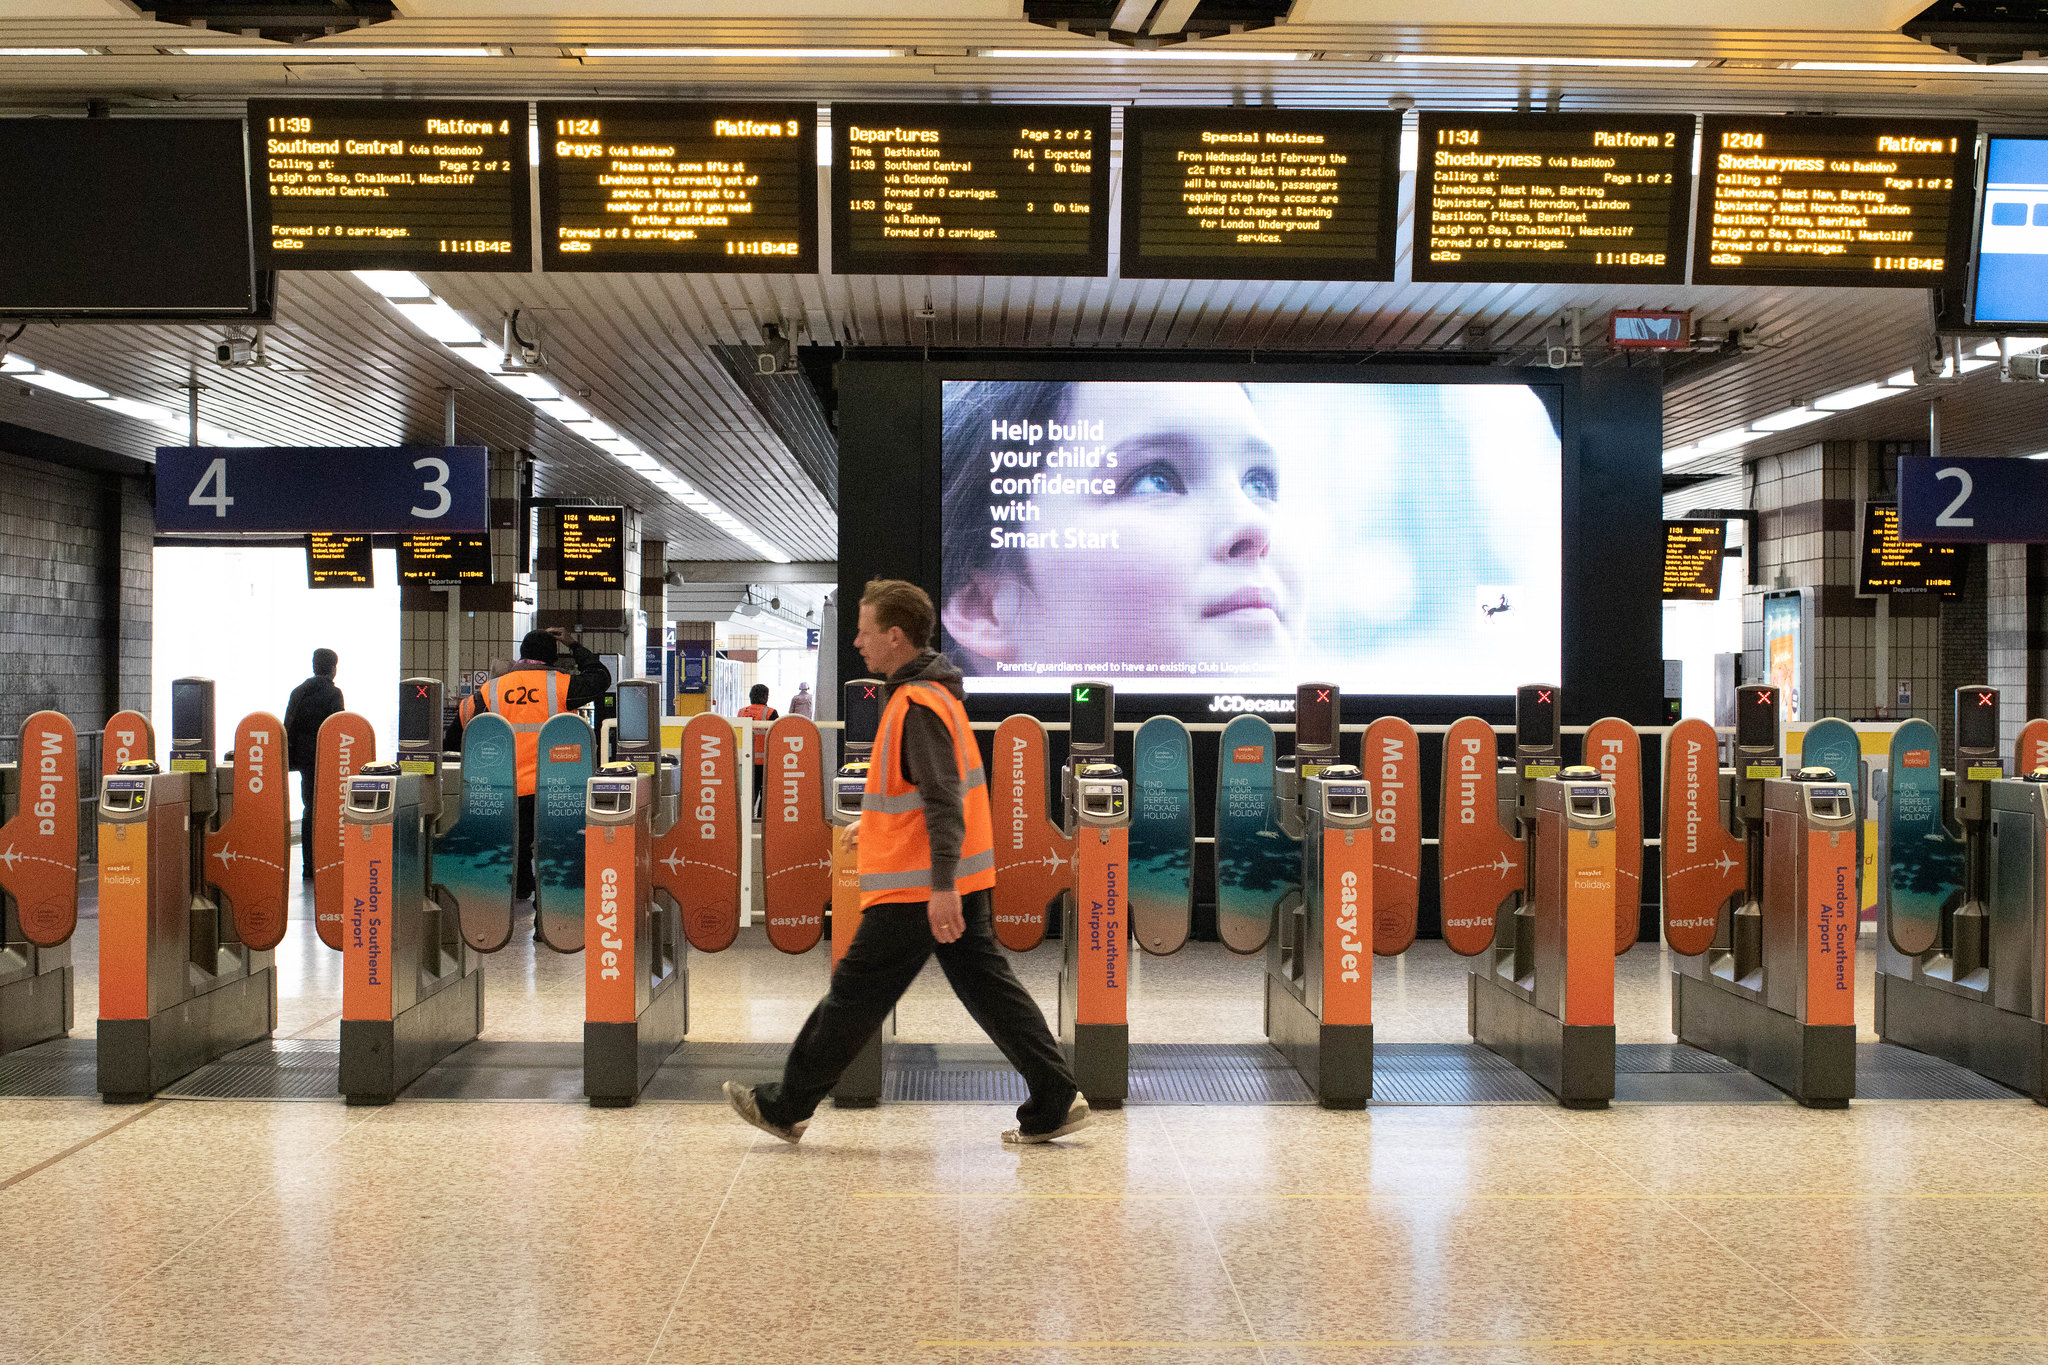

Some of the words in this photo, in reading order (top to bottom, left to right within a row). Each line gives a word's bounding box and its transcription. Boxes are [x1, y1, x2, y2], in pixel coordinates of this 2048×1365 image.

[268, 118, 310, 132] 11:39
[428, 119, 492, 134] Platform
[500, 120, 509, 134] 4
[557, 120, 599, 135] 11:24
[715, 120, 781, 136] Platform
[788, 121, 798, 136] 3
[850, 127, 939, 143] Departures
[1022, 129, 1049, 141] Page
[1054, 130, 1062, 139] 2
[1066, 130, 1079, 139] of
[1084, 131, 1091, 140] 2
[1202, 132, 1259, 143] Special
[1266, 133, 1324, 143] Notices
[1438, 130, 1479, 144] 11:34
[1594, 132, 1658, 147] Platform
[1665, 133, 1675, 147] 2
[1722, 133, 1763, 148] 12:04
[268, 139, 339, 154] Southend
[346, 140, 403, 155] Central
[410, 146, 429, 155] (via
[433, 146, 482, 156] Ockendon)
[556, 141, 602, 158] Grays
[609, 147, 628, 156] (via
[632, 147, 675, 157] Rainham)
[850, 148, 872, 156] Time
[884, 148, 940, 157] Destination
[1878, 137, 1942, 153] Platform
[1951, 138, 1957, 153] 1
[1013, 149, 1034, 158] Plat
[1045, 150, 1091, 161] Expected
[1178, 152, 1202, 161] From
[1206, 152, 1257, 164] Wednesday
[1261, 153, 1277, 163] 1st
[1281, 153, 1326, 165] February
[1330, 153, 1346, 163] the
[1435, 152, 1541, 168] Shoeburyness
[1549, 158, 1568, 167] (via
[1571, 158, 1615, 168] Basildon)
[269, 159, 313, 171] Calling
[318, 160, 334, 169] at:
[440, 161, 467, 172] Page
[473, 161, 479, 170] 2
[485, 161, 497, 170] of
[502, 162, 510, 171] 2
[612, 163, 644, 172] Please
[648, 163, 674, 173] note,
[678, 164, 703, 172] some
[707, 163, 728, 172] lifts
[733, 163, 744, 172] at
[850, 161, 875, 170] 11:39
[884, 161, 930, 170] Southend
[933, 162, 971, 171] Central
[1028, 163, 1034, 172] 4
[1054, 163, 1066, 172] On
[1071, 163, 1091, 172] time
[1187, 166, 1205, 175] c2c
[1209, 166, 1231, 175] lifts
[1235, 166, 1246, 175] at
[1250, 166, 1274, 176] West
[1278, 167, 1296, 176] Ham
[1300, 167, 1336, 176] station
[1719, 155, 1824, 172] Shoeburyness
[1830, 163, 1849, 172] (via
[1854, 163, 1897, 173] Basildon)
[270, 173, 302, 183] Leigh
[327, 173, 351, 185] Sea,
[355, 173, 415, 185] Chalkwell,
[420, 174, 474, 184] Westcliff
[1434, 185, 1496, 196] Limehouse,
[1501, 186, 1526, 195] West
[1531, 187, 1555, 197] Ham,
[1560, 187, 1604, 198] Barking
[440, 240, 511, 252] 11:18:42
[726, 242, 798, 254] 11:18:42
[1595, 253, 1665, 264] 11:18:42
[1874, 257, 1943, 269] 11:18:42
[992, 420, 1043, 445] Help
[1049, 420, 1103, 440] build
[990, 451, 1041, 472] your
[1046, 445, 1118, 468] child's
[188, 459, 234, 517] 4
[410, 458, 452, 519] 3
[990, 473, 1116, 494] confidence
[1935, 467, 1974, 527] 2
[990, 500, 1039, 521] with
[990, 528, 1059, 548] Smart
[1064, 528, 1119, 548] Start
[997, 662, 1082, 673] Parents/guardians
[1084, 662, 1108, 672] need
[1109, 664, 1120, 672] to
[1121, 662, 1144, 672] have
[1146, 664, 1157, 672] an
[1160, 663, 1196, 674] existing
[1198, 663, 1218, 673] Club
[504, 687, 539, 704] C2C
[1209, 695, 1295, 712] JCDecaux
[249, 731, 268, 793] Faro
[34, 732, 63, 835] Malaga
[696, 735, 722, 839] Malaga
[783, 737, 805, 822] Palma
[1461, 739, 1481, 824] Palma
[1012, 737, 1027, 849] Amsterdam
[1376, 738, 1403, 842] Malaga
[1687, 740, 1701, 853] Amsterdam
[104, 875, 140, 885] holidays
[369, 860, 381, 913] London
[1575, 880, 1611, 889] holidays
[1107, 863, 1119, 916] London
[1836, 866, 1847, 919] London
[354, 898, 363, 948] Airport
[596, 868, 622, 980] easyJet
[771, 915, 819, 927] easyJet
[996, 914, 1043, 924] easyJet
[1091, 901, 1101, 951] Airport
[1337, 871, 1362, 983] easyJet
[1448, 916, 1493, 928] easyJet
[1670, 917, 1714, 928] easyJet
[1820, 904, 1832, 953] Airport
[369, 918, 381, 986] Southend
[1107, 921, 1118, 988] Southend
[1836, 924, 1847, 990] Southend
